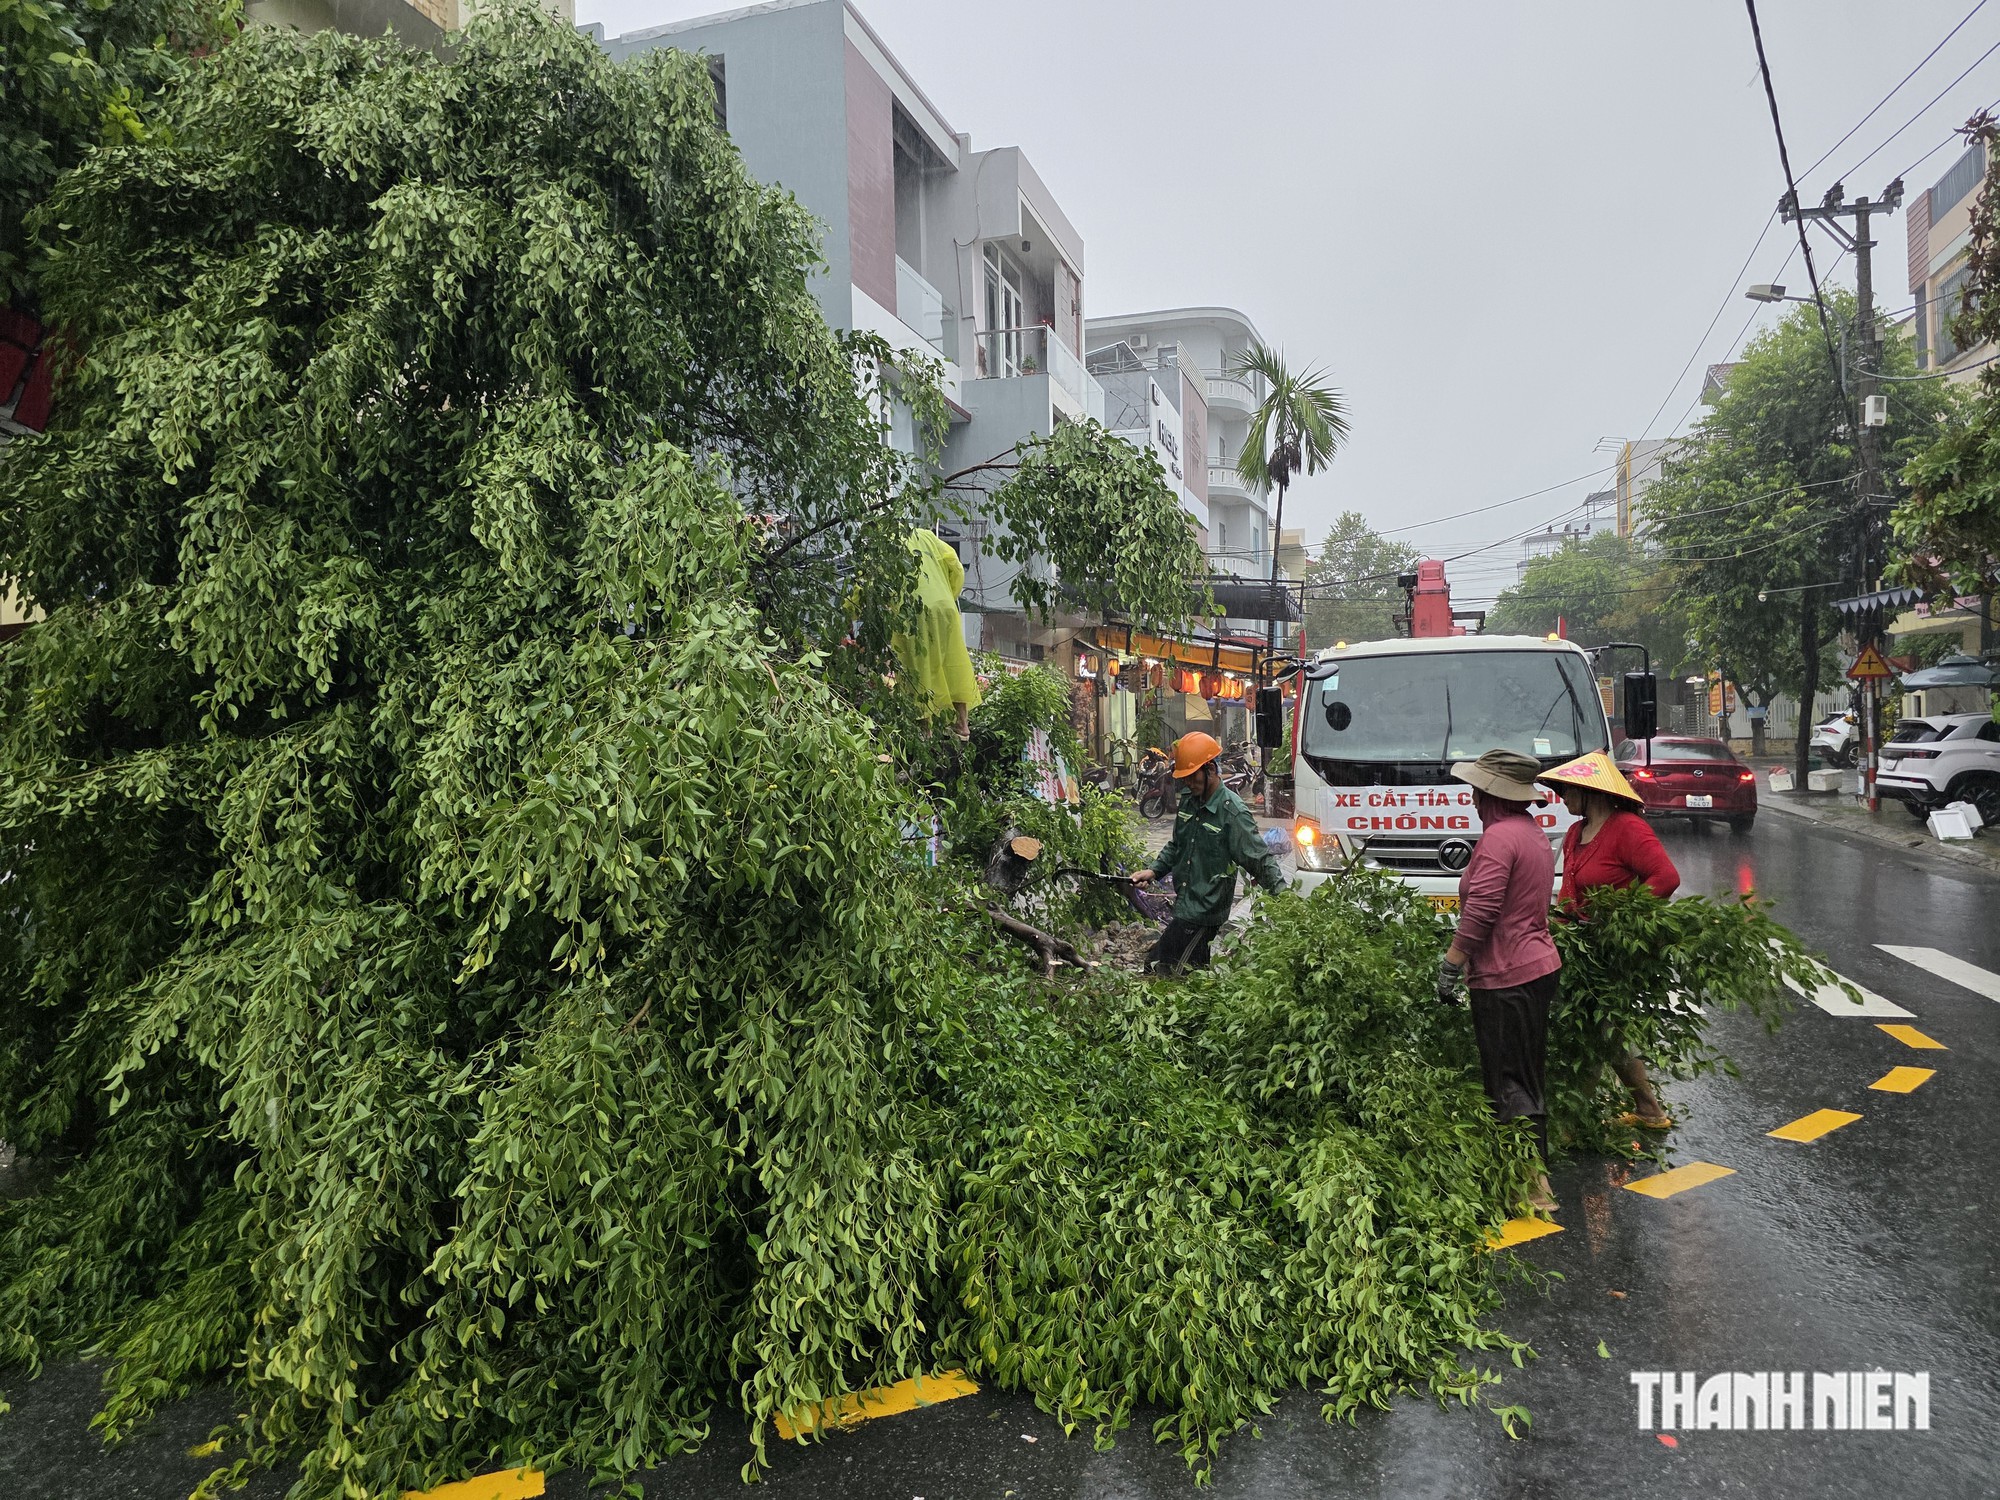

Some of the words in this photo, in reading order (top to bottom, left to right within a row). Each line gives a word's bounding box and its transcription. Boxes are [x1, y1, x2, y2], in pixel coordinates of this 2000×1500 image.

[1335, 793, 1361, 807] XE
[1368, 788, 1408, 807] CẮT
[1415, 788, 1450, 806] TỈA
[1347, 811, 1470, 830] CHỐNG
